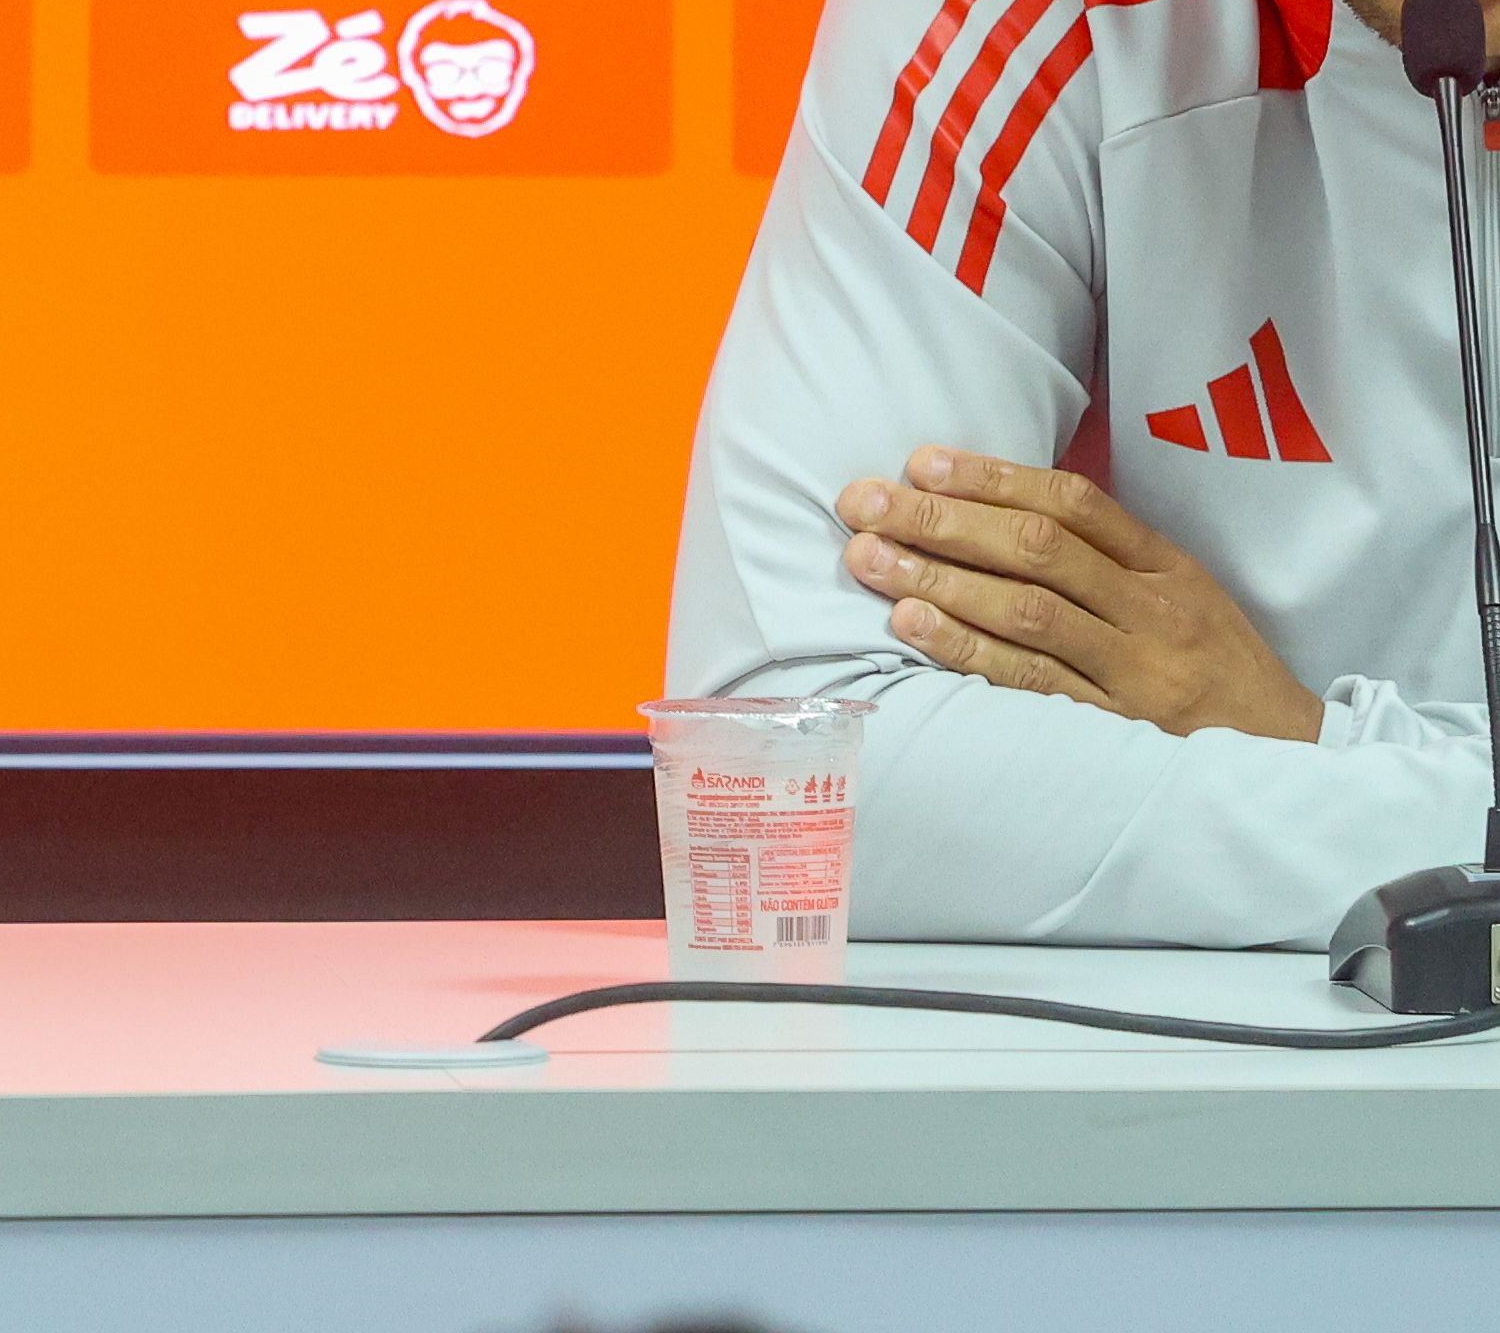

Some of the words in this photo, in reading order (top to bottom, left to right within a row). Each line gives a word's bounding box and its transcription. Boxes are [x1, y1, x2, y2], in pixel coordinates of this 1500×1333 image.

[229, 10, 397, 100] Zé
[229, 101, 398, 130] DELIVERY
[707, 775, 765, 792] SARANDI
